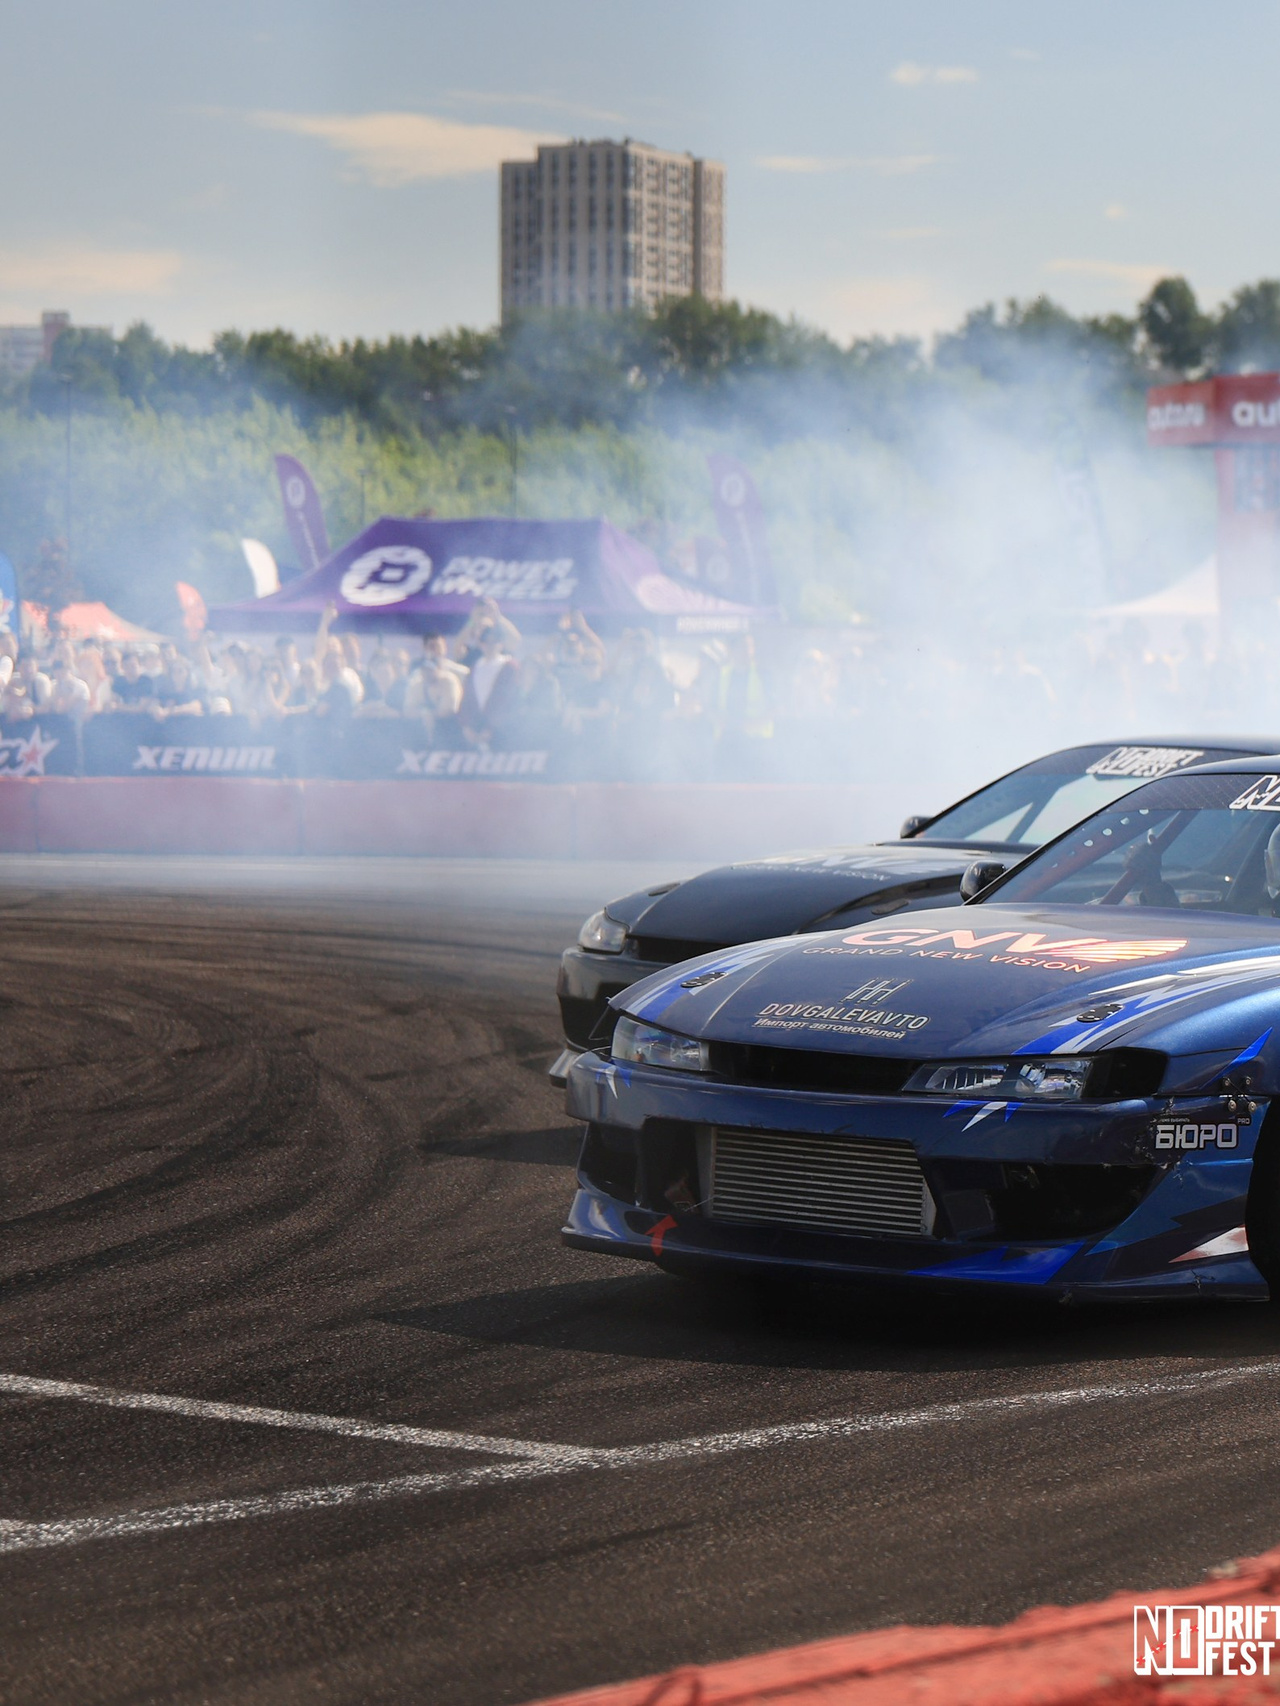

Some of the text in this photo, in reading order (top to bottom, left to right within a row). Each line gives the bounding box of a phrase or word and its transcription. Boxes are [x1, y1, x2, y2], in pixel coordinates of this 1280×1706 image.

[442, 556, 575, 580] POWER
[133, 745, 276, 771] XENUM
[397, 748, 549, 775] XENUM
[842, 929, 1102, 955] GNV
[803, 946, 1091, 974] GRAND NEW VISION
[754, 1018, 906, 1040] Импорт автомобилей
[758, 1003, 930, 1030] DOVGALEVAVTO
[1155, 1123, 1237, 1149] БЮРО
